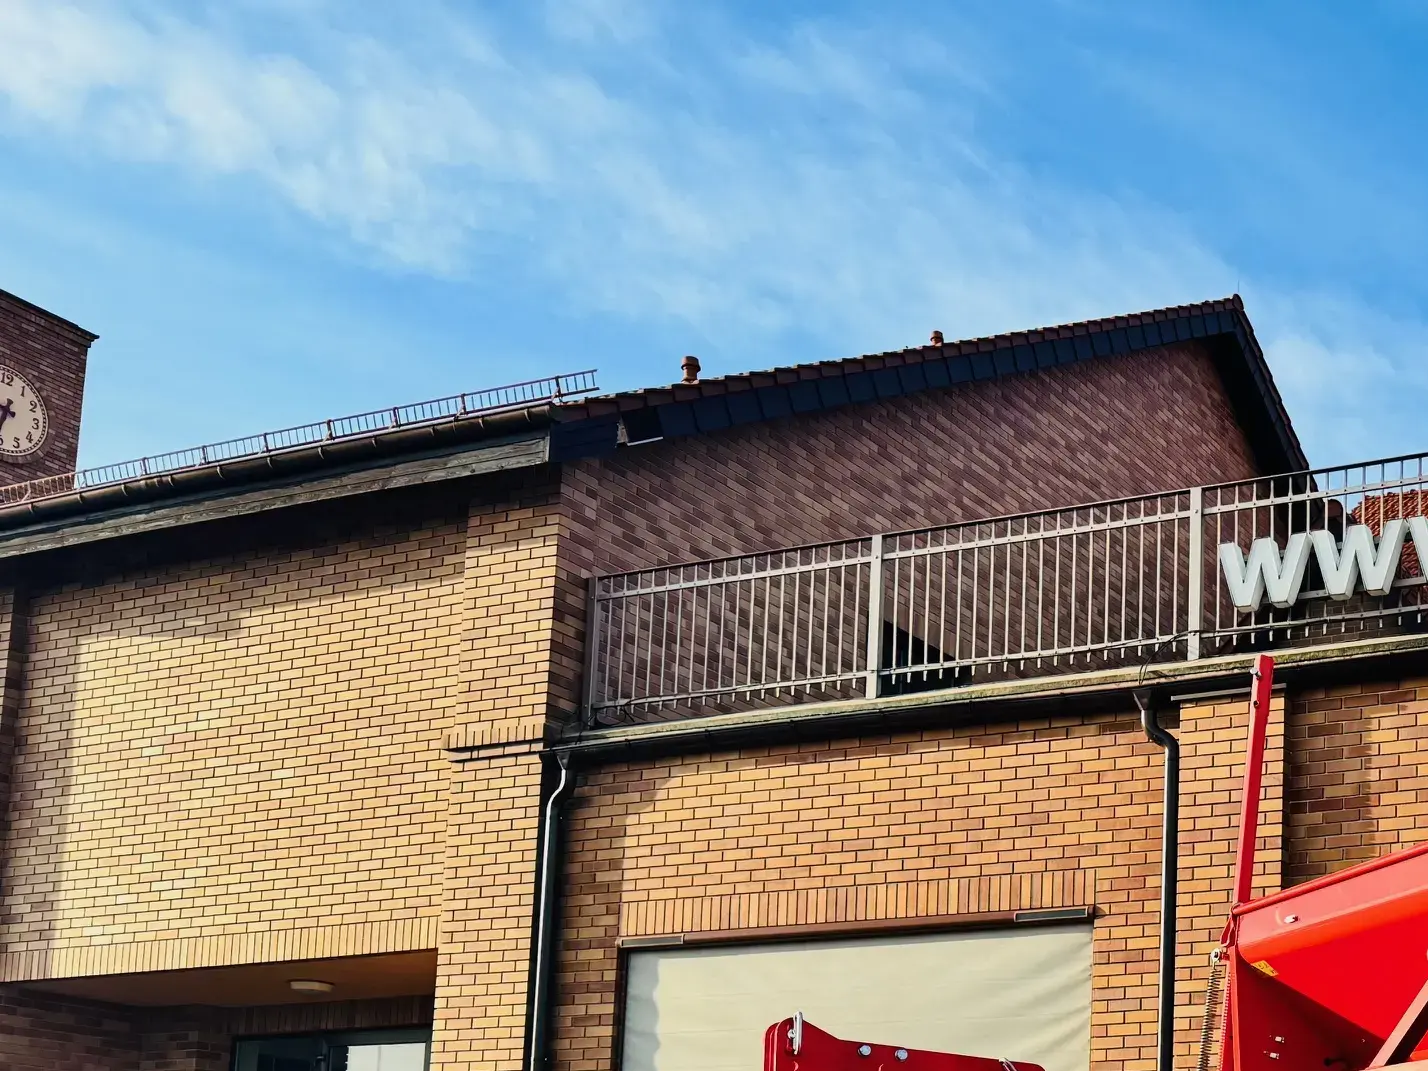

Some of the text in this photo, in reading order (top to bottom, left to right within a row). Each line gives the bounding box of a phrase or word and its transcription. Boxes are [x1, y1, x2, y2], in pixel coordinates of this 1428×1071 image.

[0, 371, 14, 386] 12
[20, 386, 26, 398] 1
[29, 400, 37, 413] 2
[32, 418, 40, 430] 3
[12, 436, 20, 449] 5
[25, 431, 34, 444] 4
